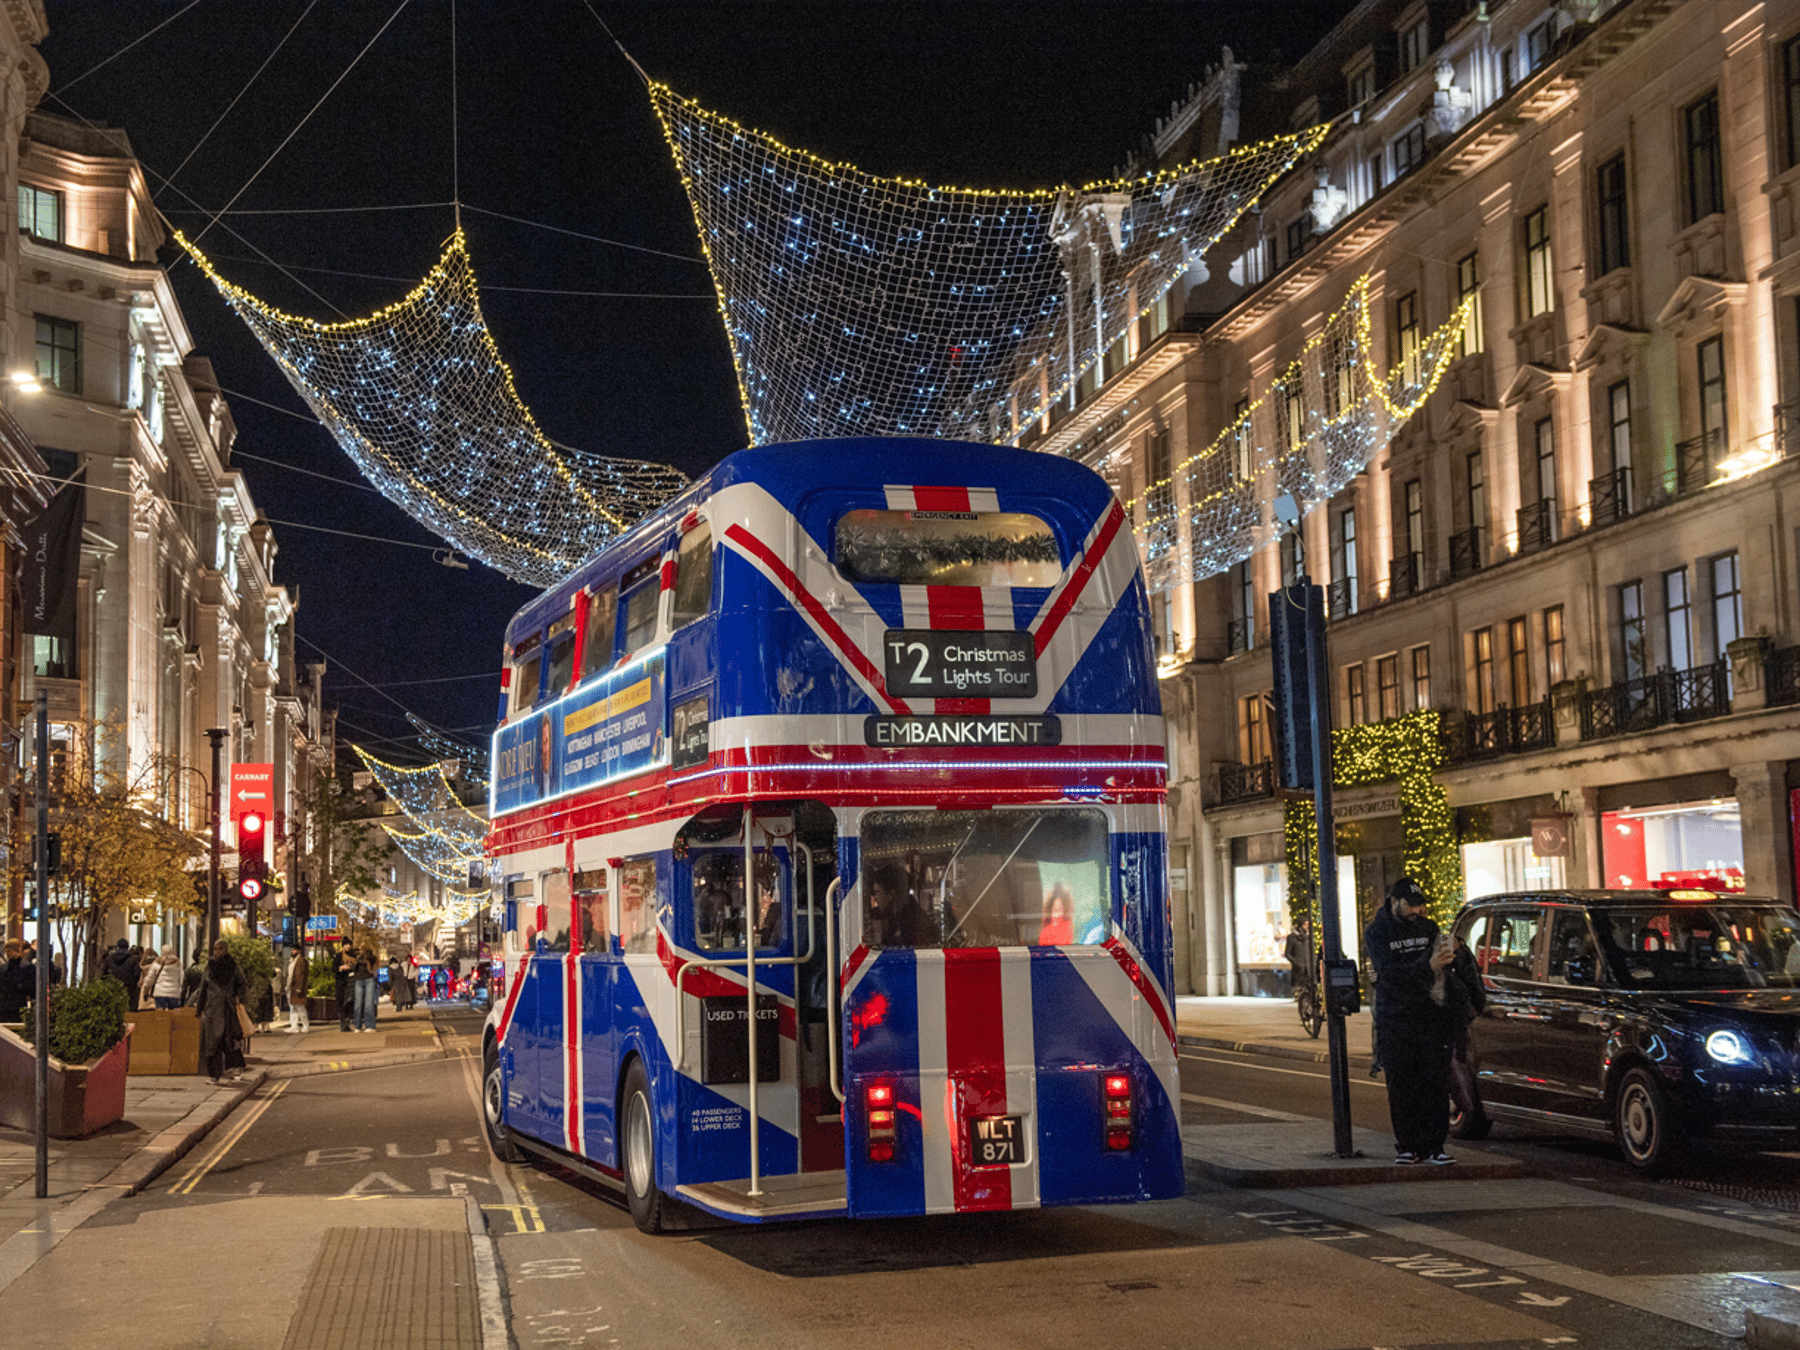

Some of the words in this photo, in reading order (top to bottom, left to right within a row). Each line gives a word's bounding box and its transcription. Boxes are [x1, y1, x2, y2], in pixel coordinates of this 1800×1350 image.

[943, 645, 1026, 662] Christmas
[943, 668, 992, 689] Lights
[995, 668, 1031, 684] Tour
[876, 722, 1043, 743] EMBANKMENT
[235, 773, 269, 781] CARNABY
[707, 1011, 735, 1021] USED
[700, 1115, 723, 1124] LOWER
[724, 1114, 742, 1122] DECK
[701, 1107, 742, 1116] PASSENGERS
[701, 1123, 722, 1132] UPPER
[723, 1122, 741, 1131] DECK
[977, 1120, 1015, 1139] WLT
[983, 1142, 1014, 1161] 871
[1370, 1253, 1527, 1288] LOOK
